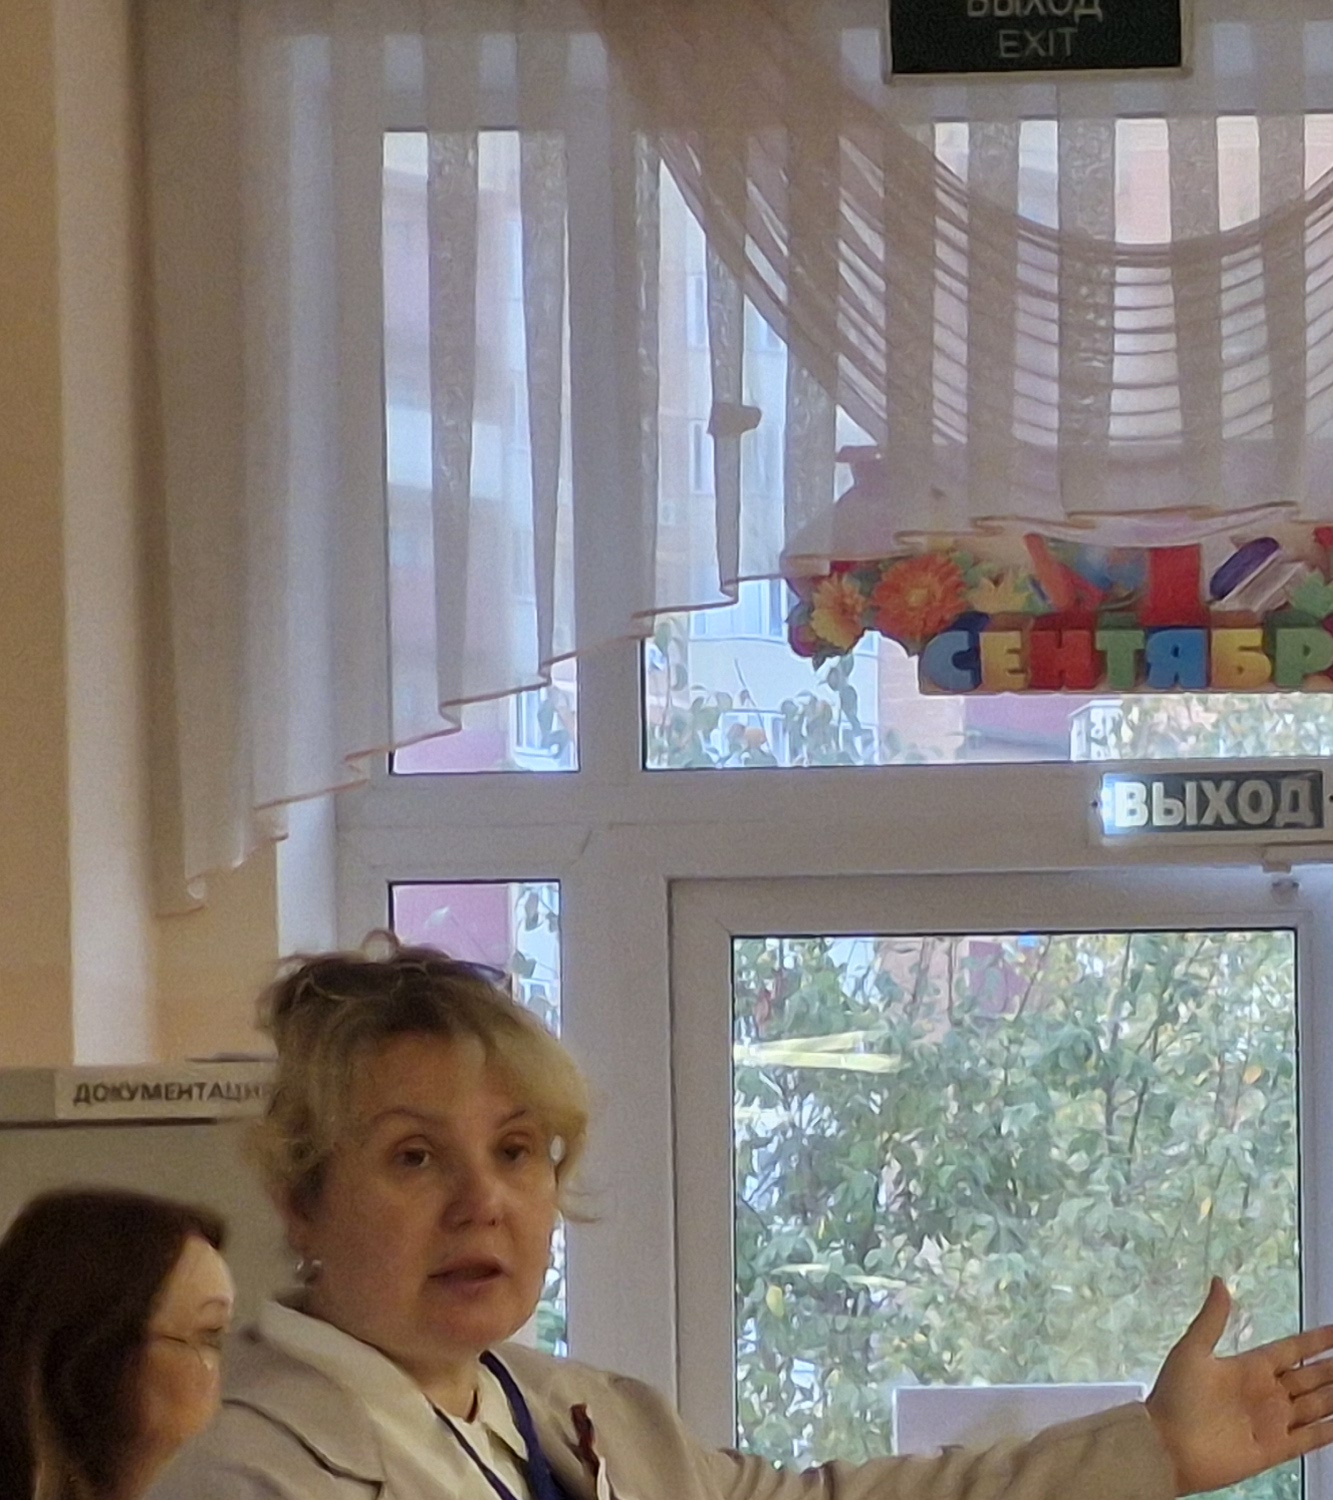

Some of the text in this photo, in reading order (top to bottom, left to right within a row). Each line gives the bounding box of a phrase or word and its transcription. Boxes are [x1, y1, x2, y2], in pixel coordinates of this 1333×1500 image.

[999, 27, 1078, 58] EXIT
[1114, 779, 1314, 828] ВЫХОД
[73, 1081, 266, 1106] ДОКУМЕНТАЦИ
